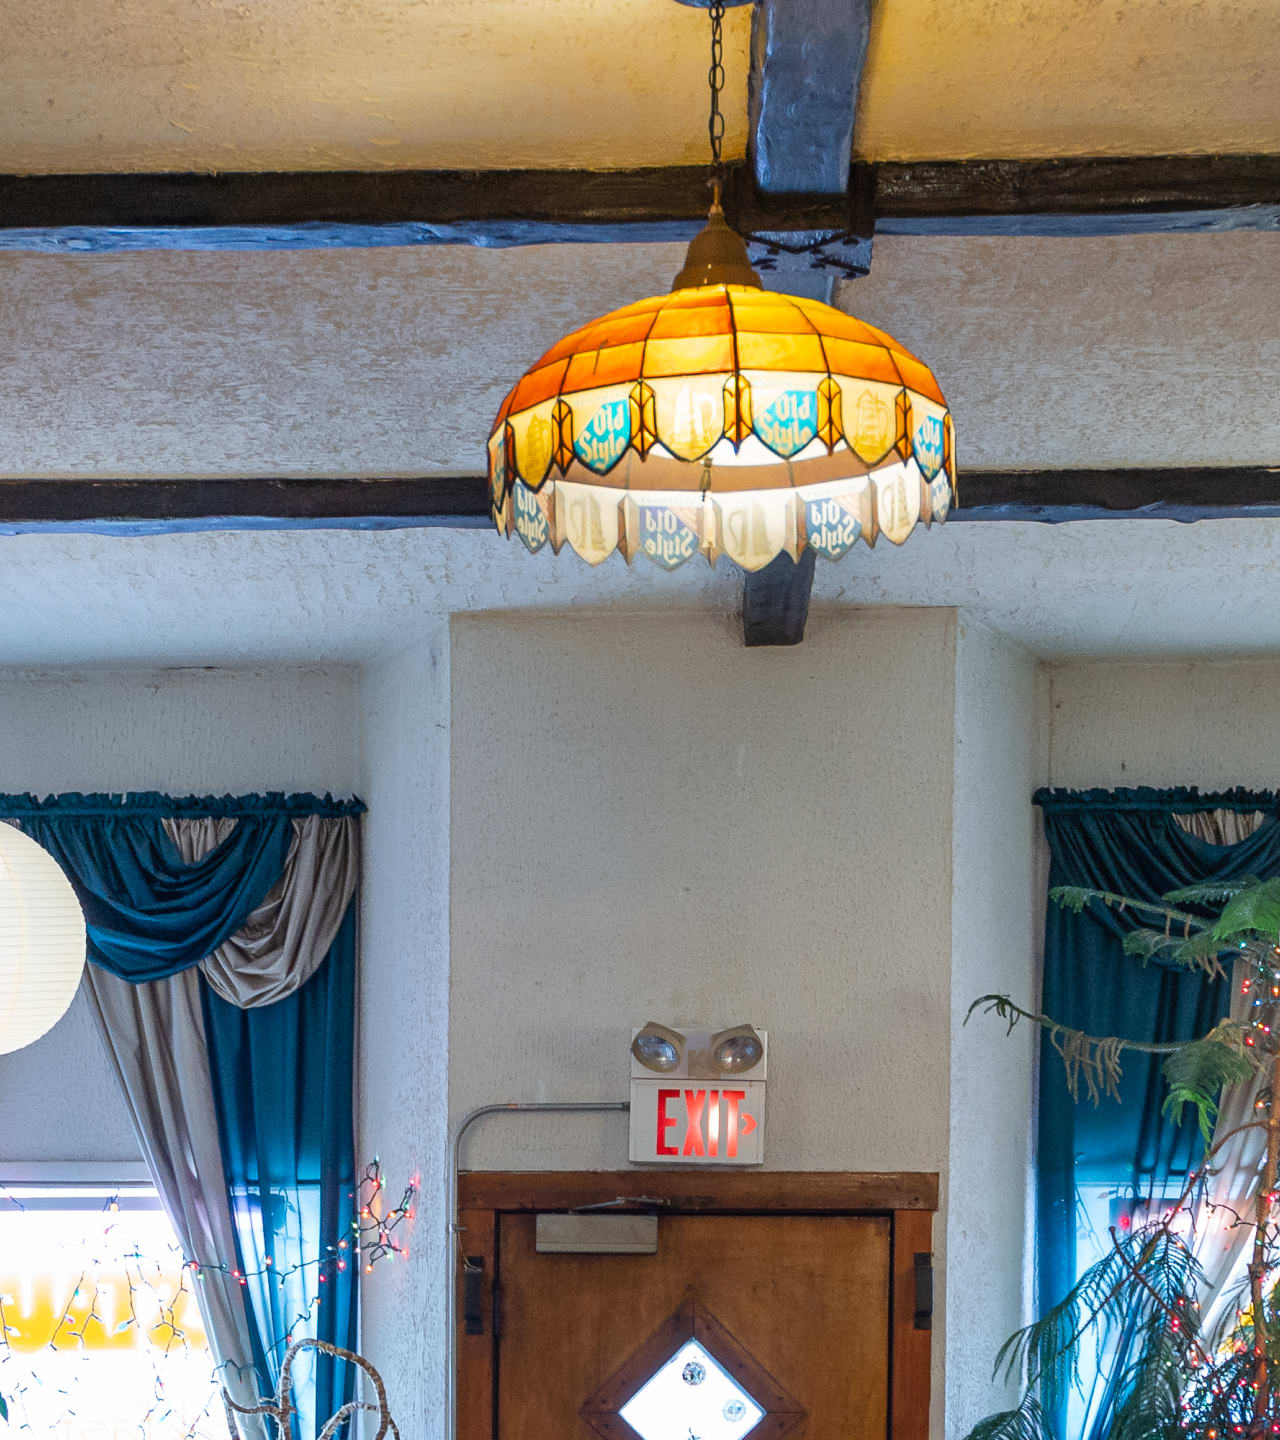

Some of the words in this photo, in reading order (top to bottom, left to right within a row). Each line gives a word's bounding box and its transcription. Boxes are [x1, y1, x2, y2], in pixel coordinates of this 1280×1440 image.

[593, 403, 624, 436] Old
[776, 392, 810, 421] Old
[579, 430, 627, 469] Style
[758, 411, 813, 454] Style
[656, 1089, 746, 1158] EXIT
